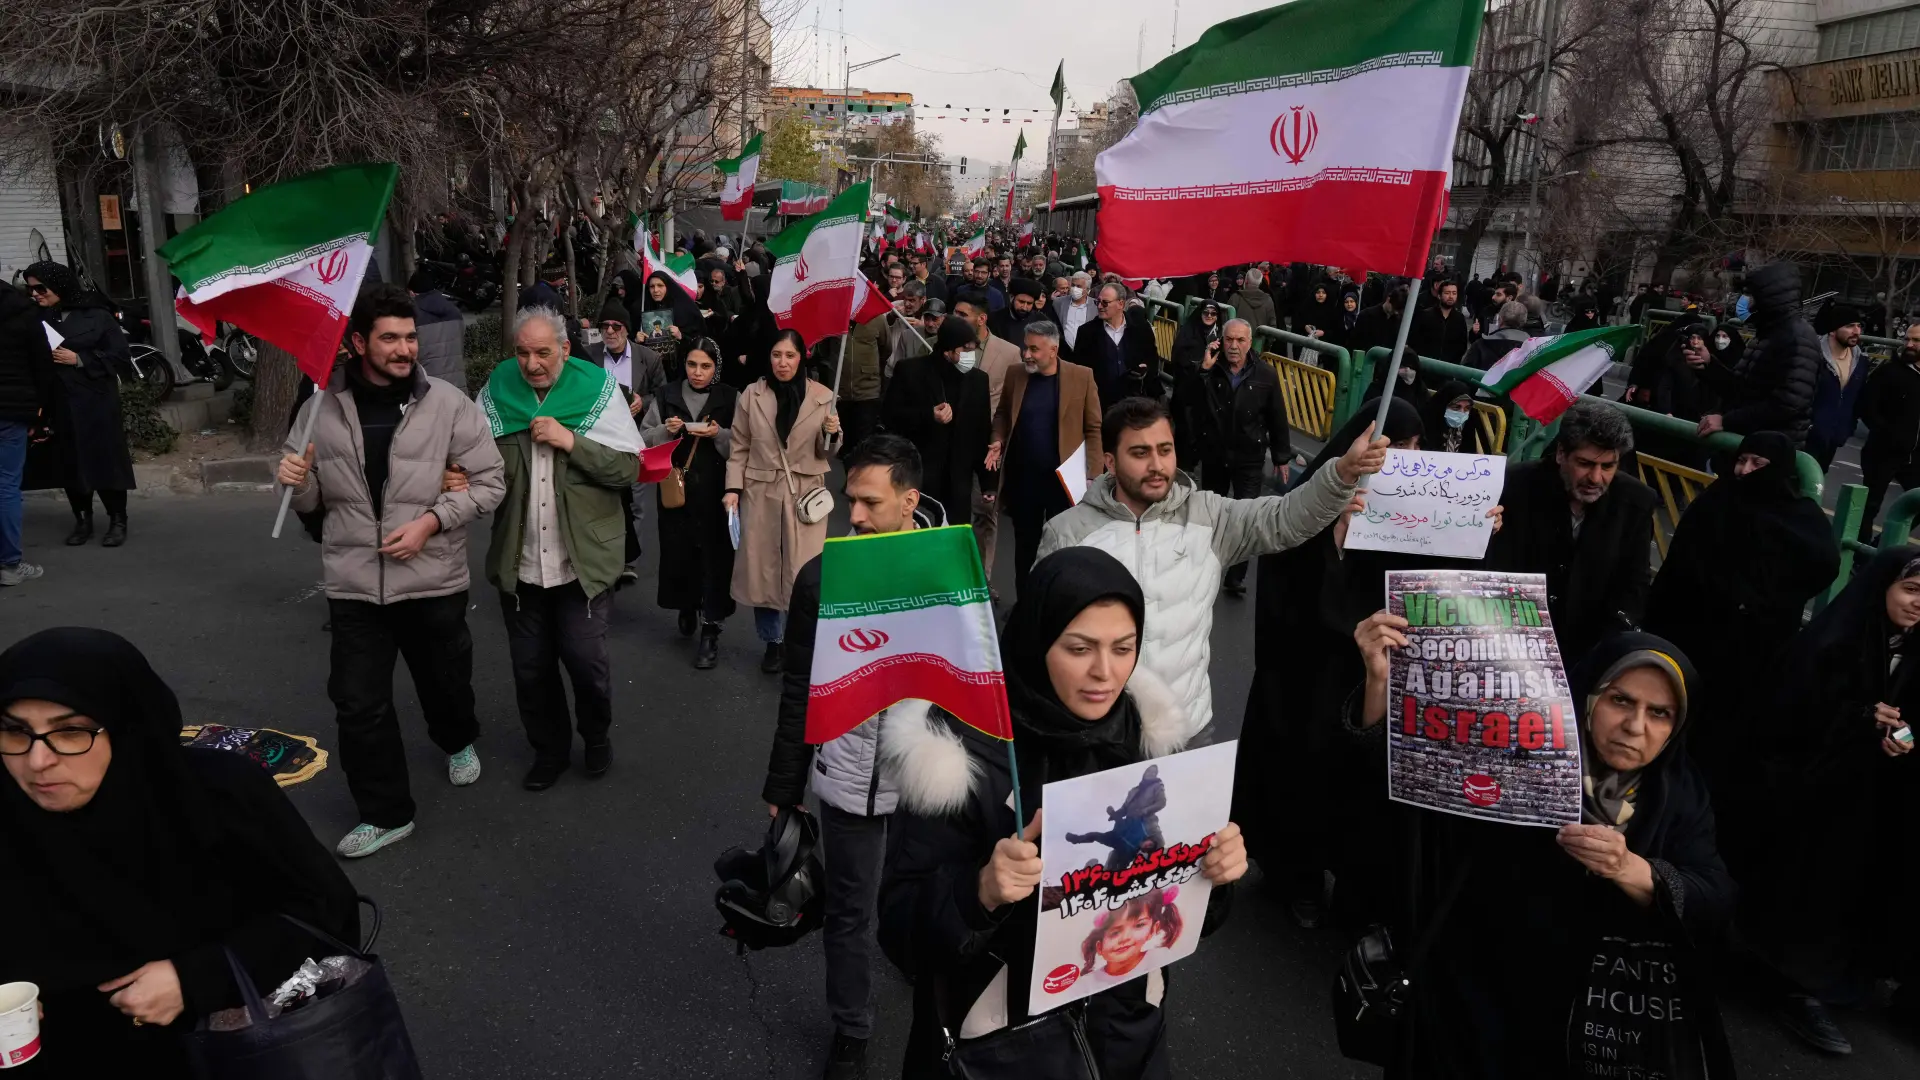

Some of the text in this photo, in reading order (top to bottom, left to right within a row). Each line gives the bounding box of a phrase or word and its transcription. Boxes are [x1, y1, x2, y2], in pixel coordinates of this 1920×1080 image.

[1828, 67, 1866, 105] BANK
[1868, 61, 1910, 100] MELLI
[1390, 512, 1429, 528] مردود
[1403, 592, 1541, 628] Victory in
[1405, 633, 1548, 661] Second War
[1405, 662, 1557, 700] Against
[1403, 696, 1566, 750] Israel
[1061, 864, 1111, 894] ۱۳۶۰
[1060, 886, 1109, 919] ۱۴۰۴
[1590, 954, 1677, 984] PANTS
[1583, 1041, 1617, 1060] IS IN
